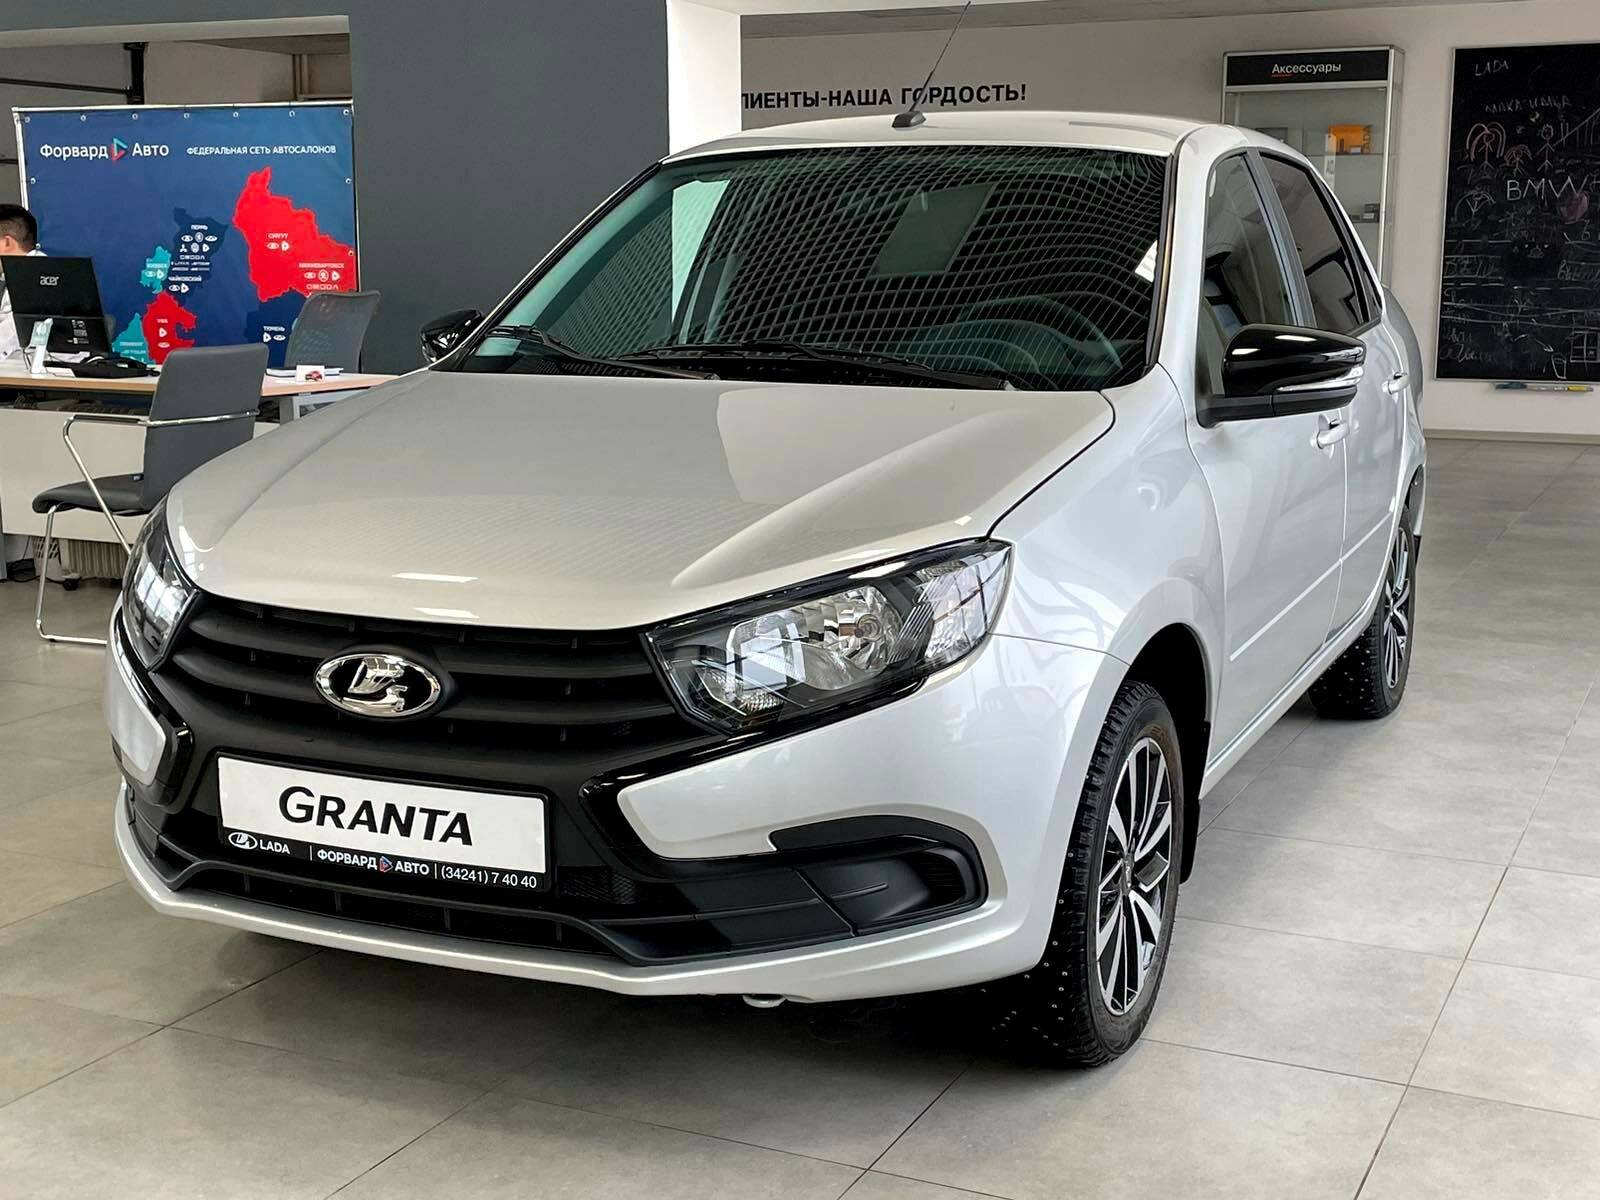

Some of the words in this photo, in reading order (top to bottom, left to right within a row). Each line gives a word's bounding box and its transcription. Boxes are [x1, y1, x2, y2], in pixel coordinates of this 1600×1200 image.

[1272, 63, 1341, 76] Аксессуары
[901, 84, 1027, 106] ГОРДОСТЬ!
[40, 143, 108, 161] Форвард
[132, 142, 169, 157] Авто
[186, 146, 248, 156] ФЕДЕРАЛЬНАЯ
[249, 146, 271, 155] СЕТЬ
[272, 145, 337, 155] АВТОСАЛОНОВ
[1506, 174, 1588, 201] BMW
[39, 276, 60, 286] acer
[278, 785, 474, 847] GRANTA
[259, 839, 291, 855] LADA
[316, 848, 378, 871] ФОРВАРД
[394, 860, 430, 876] АВТО
[440, 866, 489, 885] (34241)
[491, 871, 500, 884] 7
[502, 873, 519, 887] 40
[520, 875, 538, 889] 40
